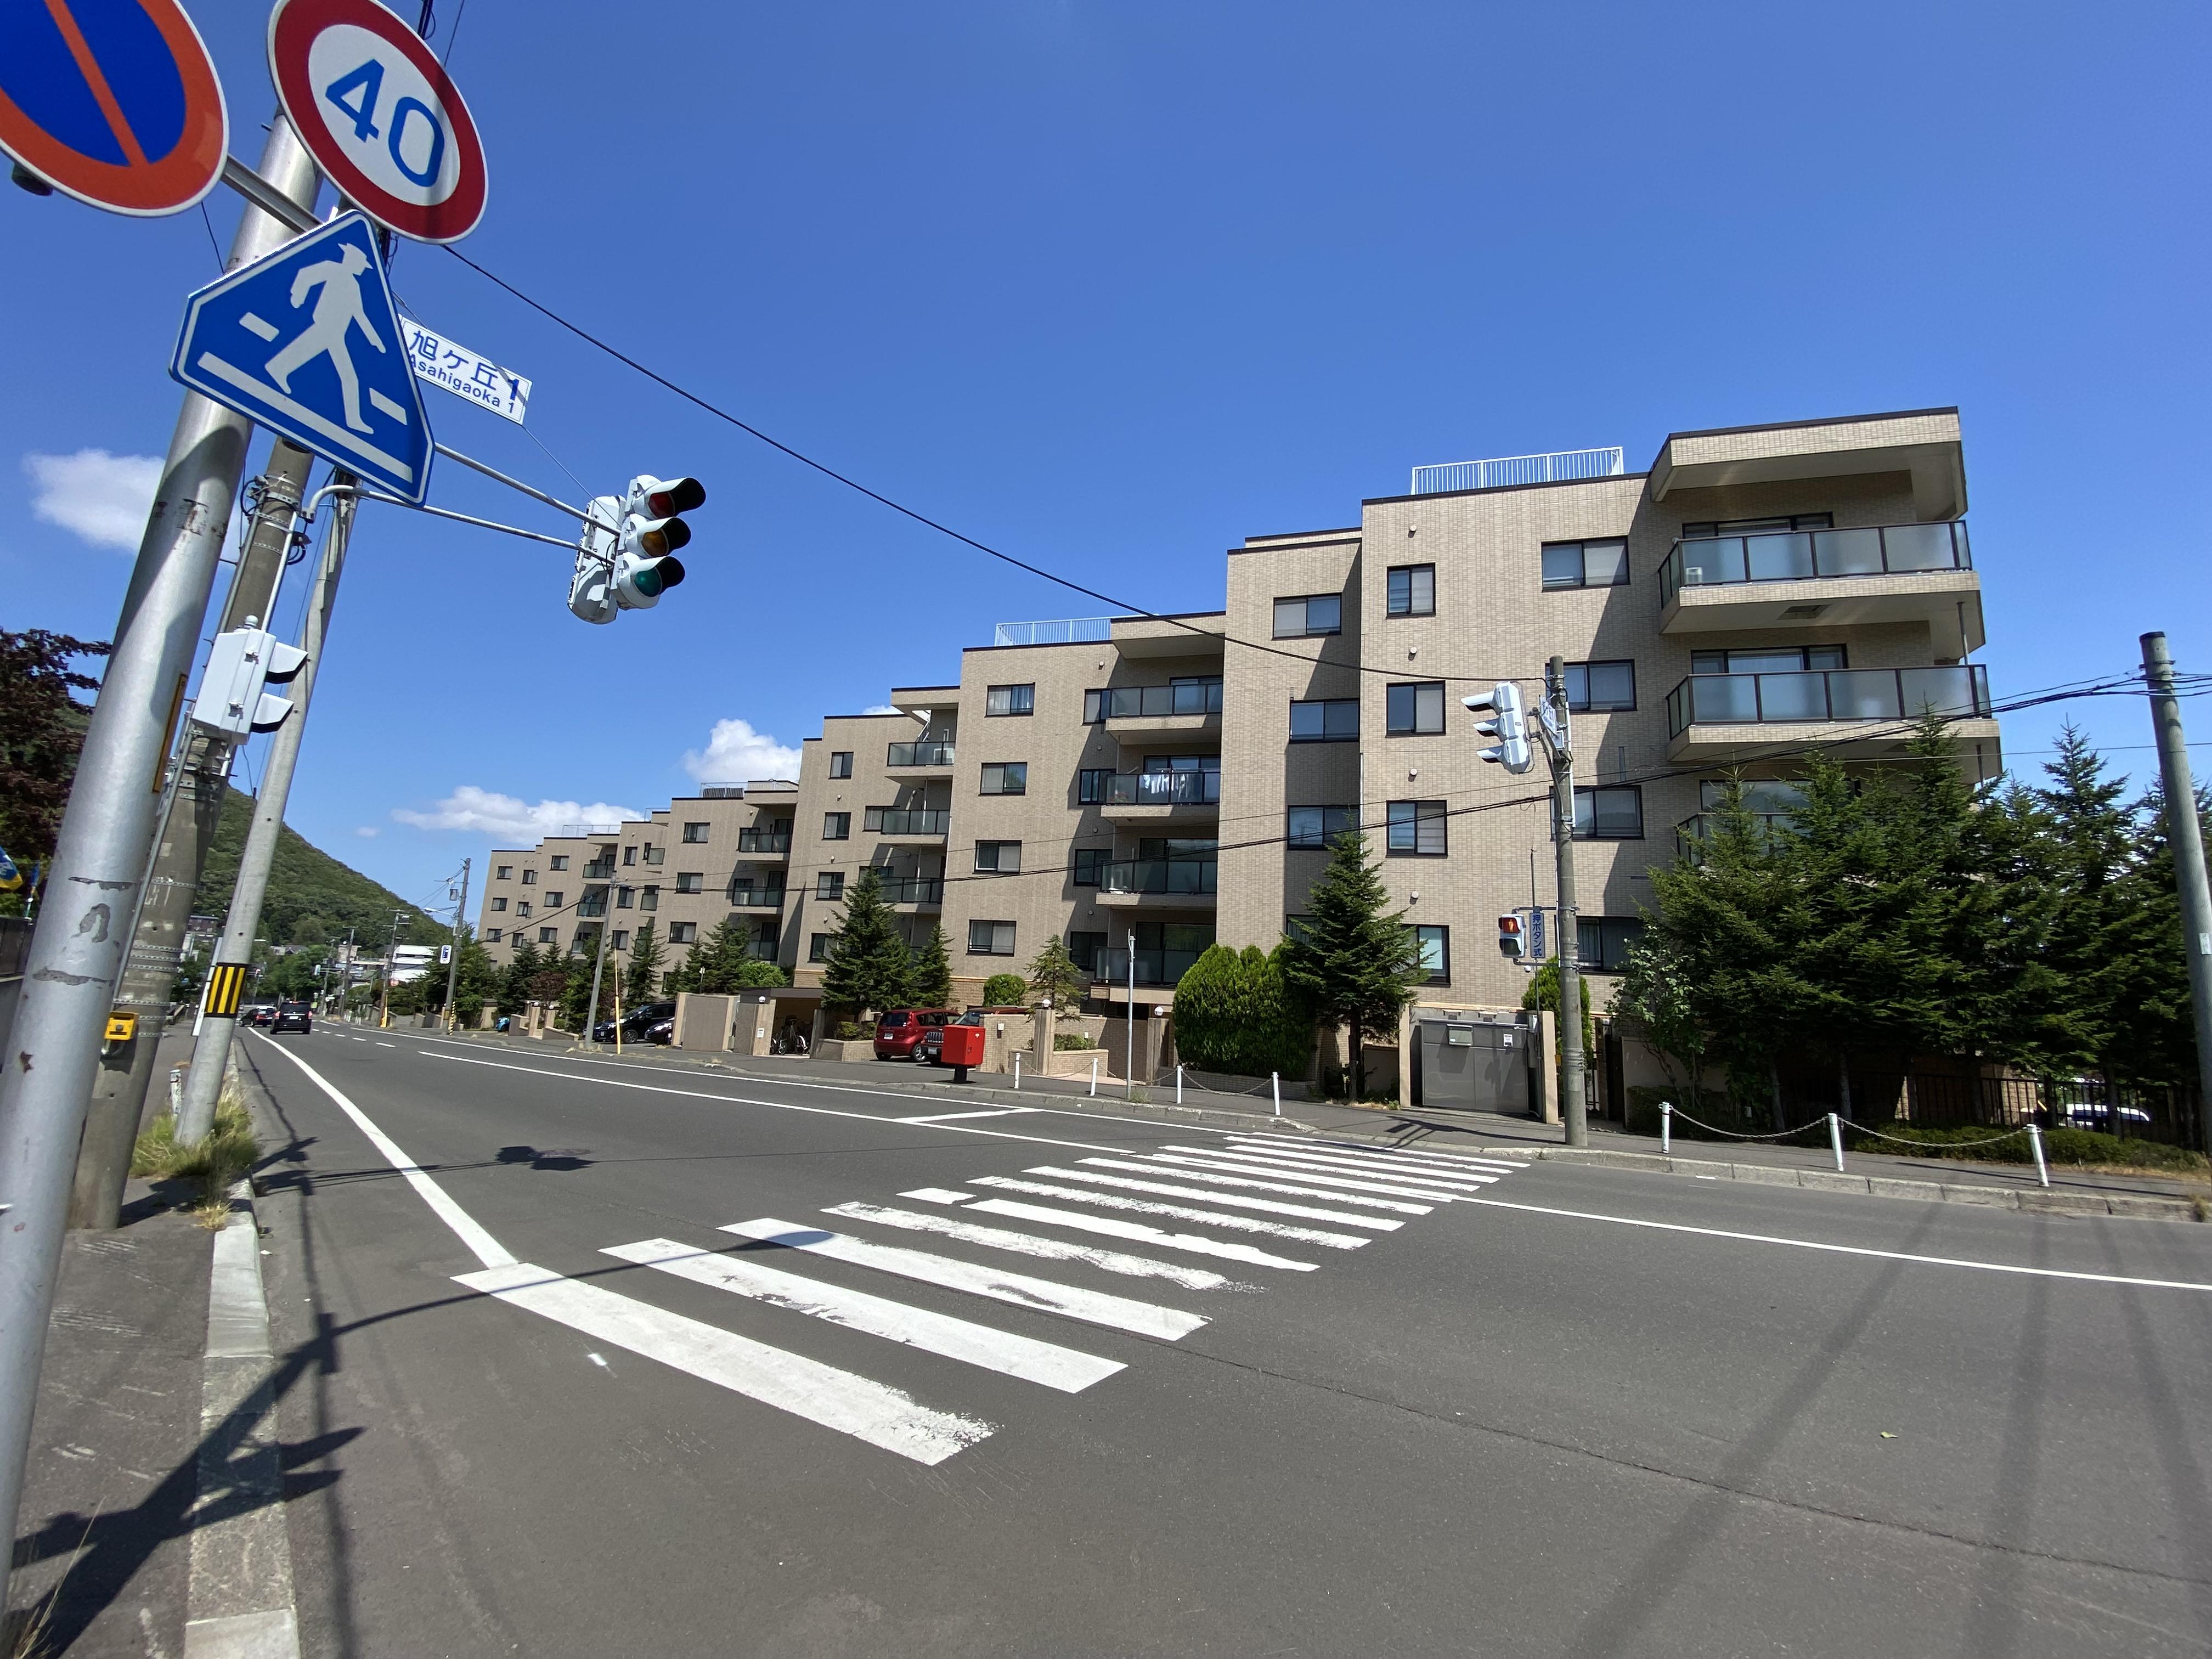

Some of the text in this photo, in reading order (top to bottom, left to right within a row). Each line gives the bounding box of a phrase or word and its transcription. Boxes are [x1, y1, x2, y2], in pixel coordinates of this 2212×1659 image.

[325, 59, 445, 188] 40
[508, 402, 515, 414] 1
[1532, 914, 1542, 957] 押ボタン式
